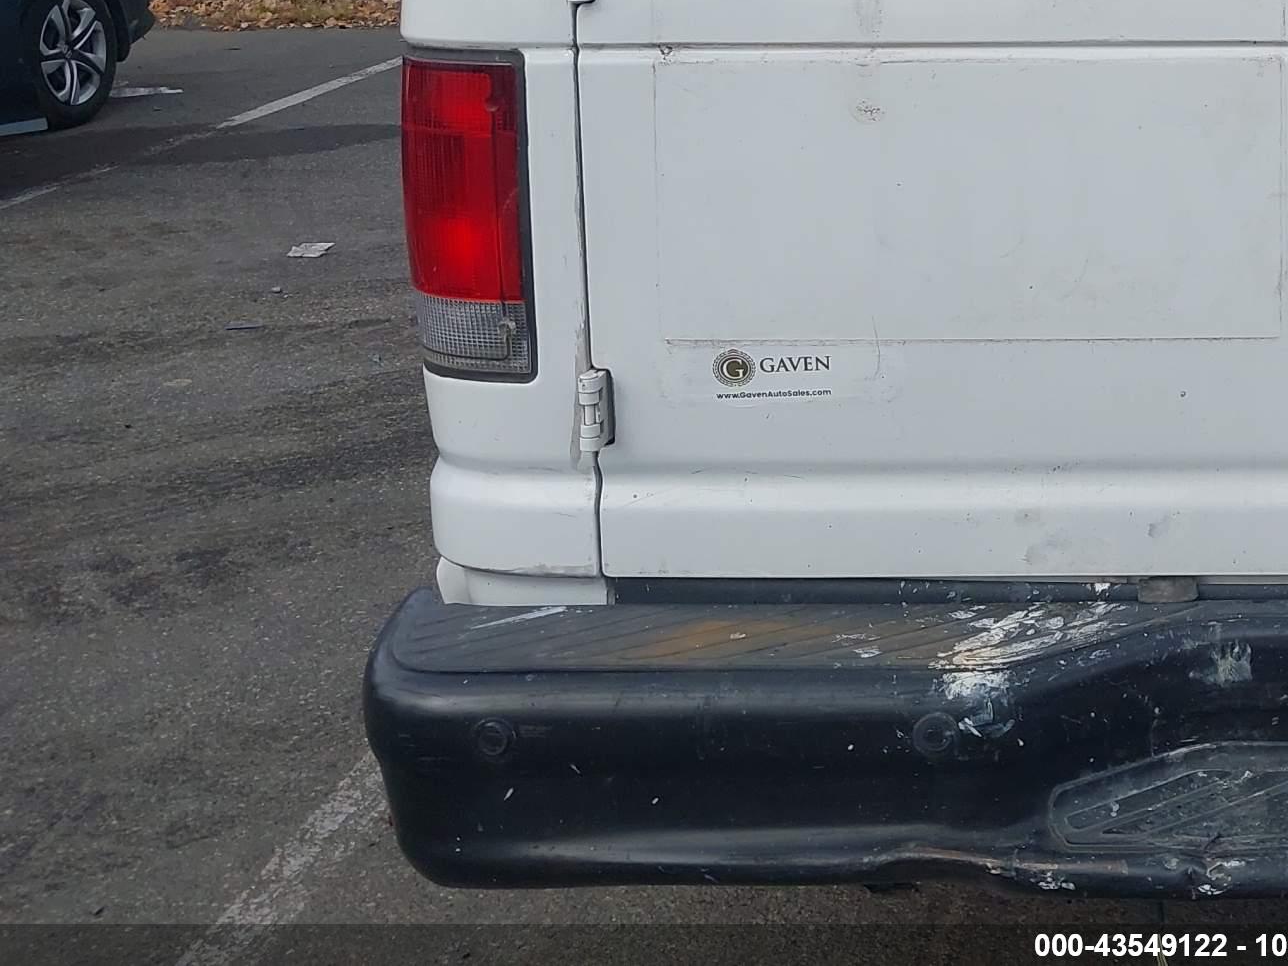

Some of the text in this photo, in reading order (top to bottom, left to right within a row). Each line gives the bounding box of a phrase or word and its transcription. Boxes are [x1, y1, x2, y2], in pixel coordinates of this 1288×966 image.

[723, 356, 832, 379] G GAVEN
[716, 389, 832, 399] www.GavenAutoSales.com
